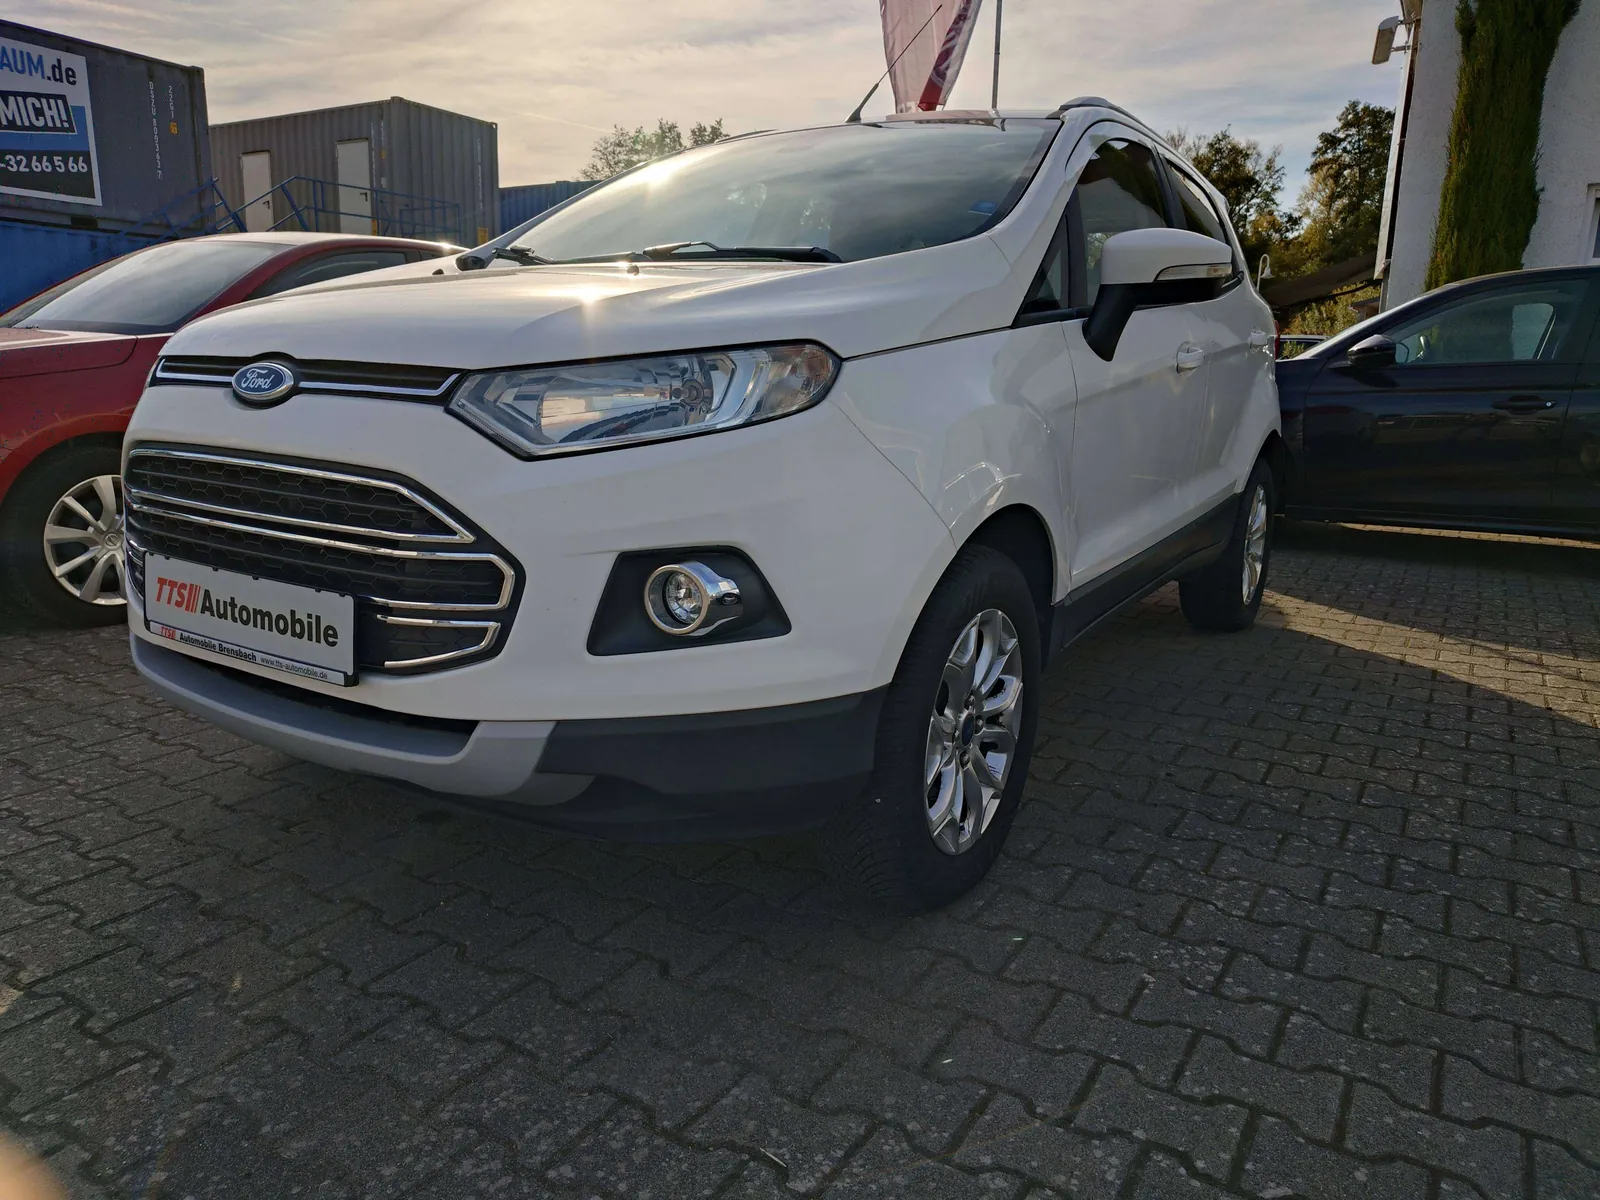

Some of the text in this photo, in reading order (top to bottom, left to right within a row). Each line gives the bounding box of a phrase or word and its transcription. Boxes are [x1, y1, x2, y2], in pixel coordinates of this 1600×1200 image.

[0, 95, 69, 128] MICH!
[241, 368, 275, 389] Ford
[200, 588, 339, 648] Automobile
[179, 632, 217, 651] Automobile
[218, 643, 257, 662] Brensbach
[260, 657, 328, 680] www.tts-automobile.de
